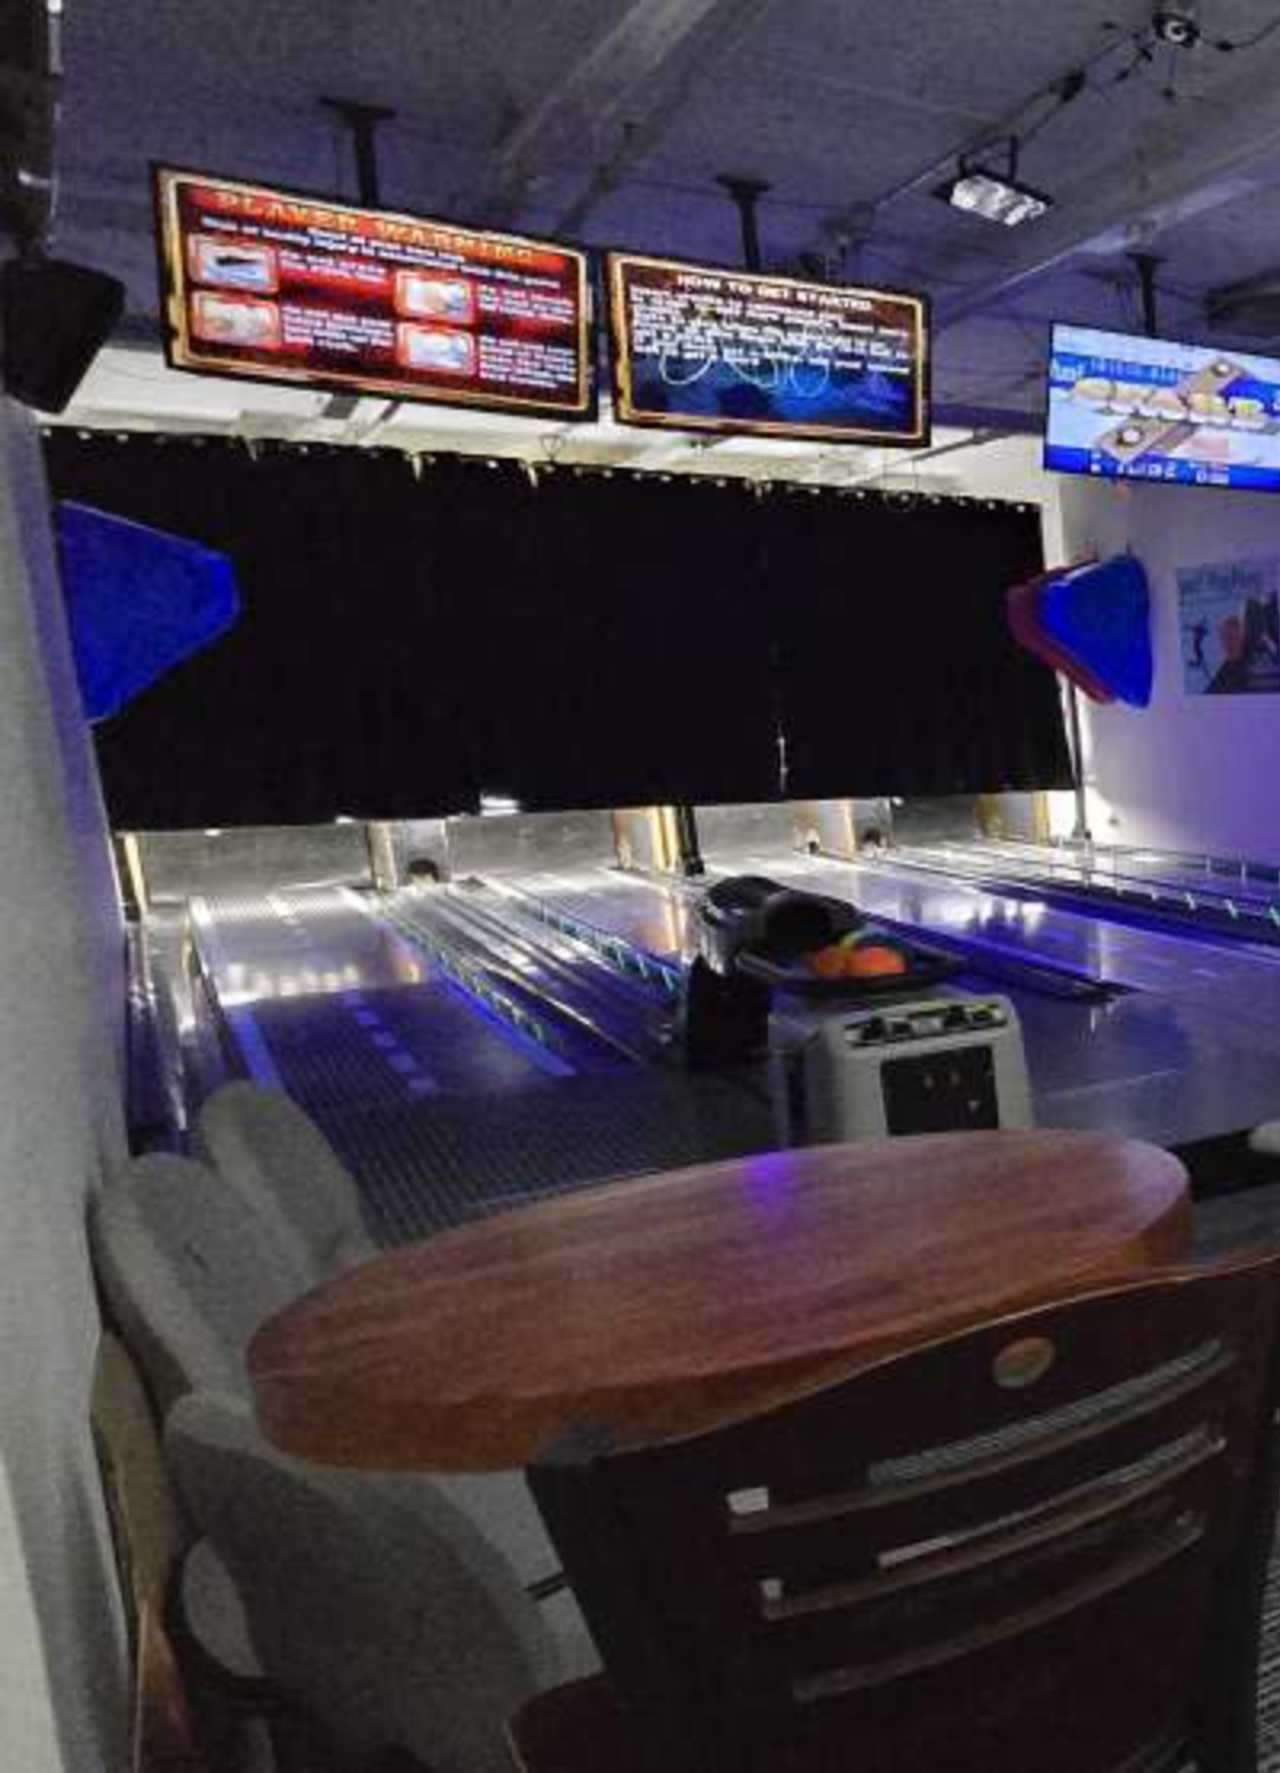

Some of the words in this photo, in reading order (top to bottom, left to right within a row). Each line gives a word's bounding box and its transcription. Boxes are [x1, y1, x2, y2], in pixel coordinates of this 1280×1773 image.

[216, 191, 357, 232] PLAYER
[374, 220, 533, 262] WARNING
[676, 273, 721, 291] HOW
[728, 280, 753, 295] TO
[757, 284, 790, 300] GET
[795, 290, 874, 311] STARTED
